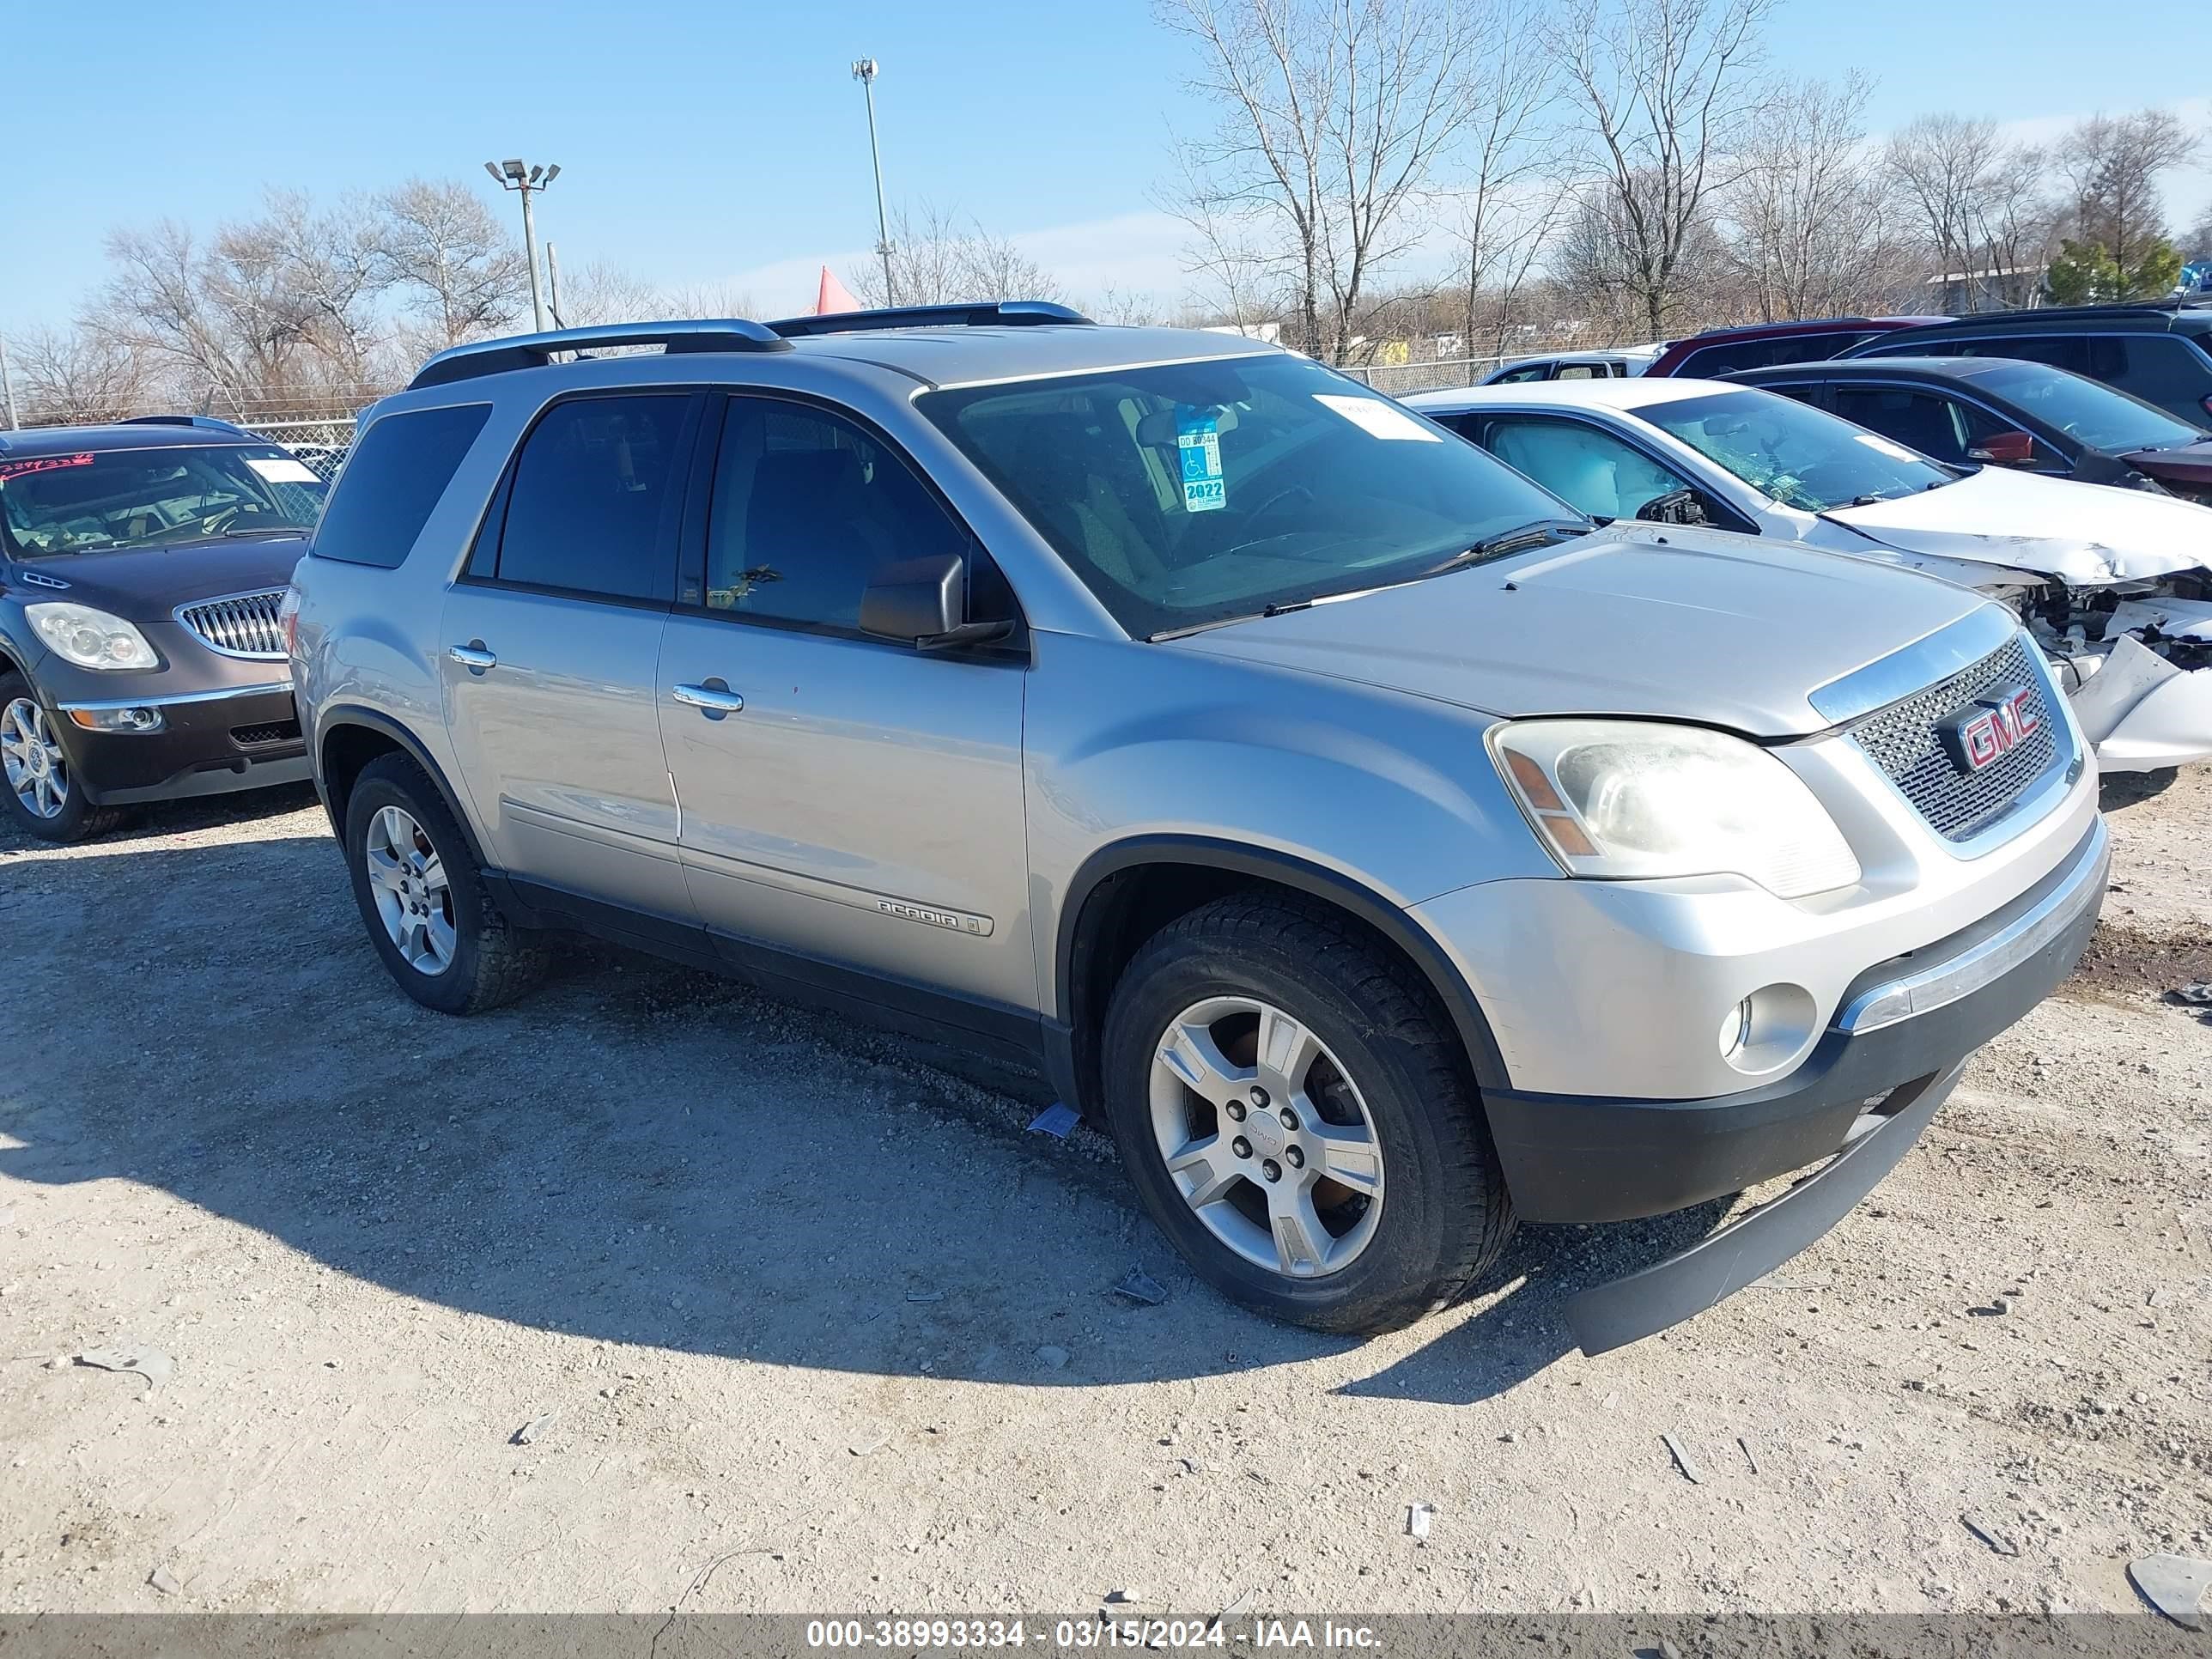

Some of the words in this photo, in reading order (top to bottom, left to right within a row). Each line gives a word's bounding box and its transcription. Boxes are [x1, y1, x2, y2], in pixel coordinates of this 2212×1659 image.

[1187, 482, 1223, 499] 2022
[1964, 688, 2039, 769] GMC
[877, 899, 958, 927] ACADIA
